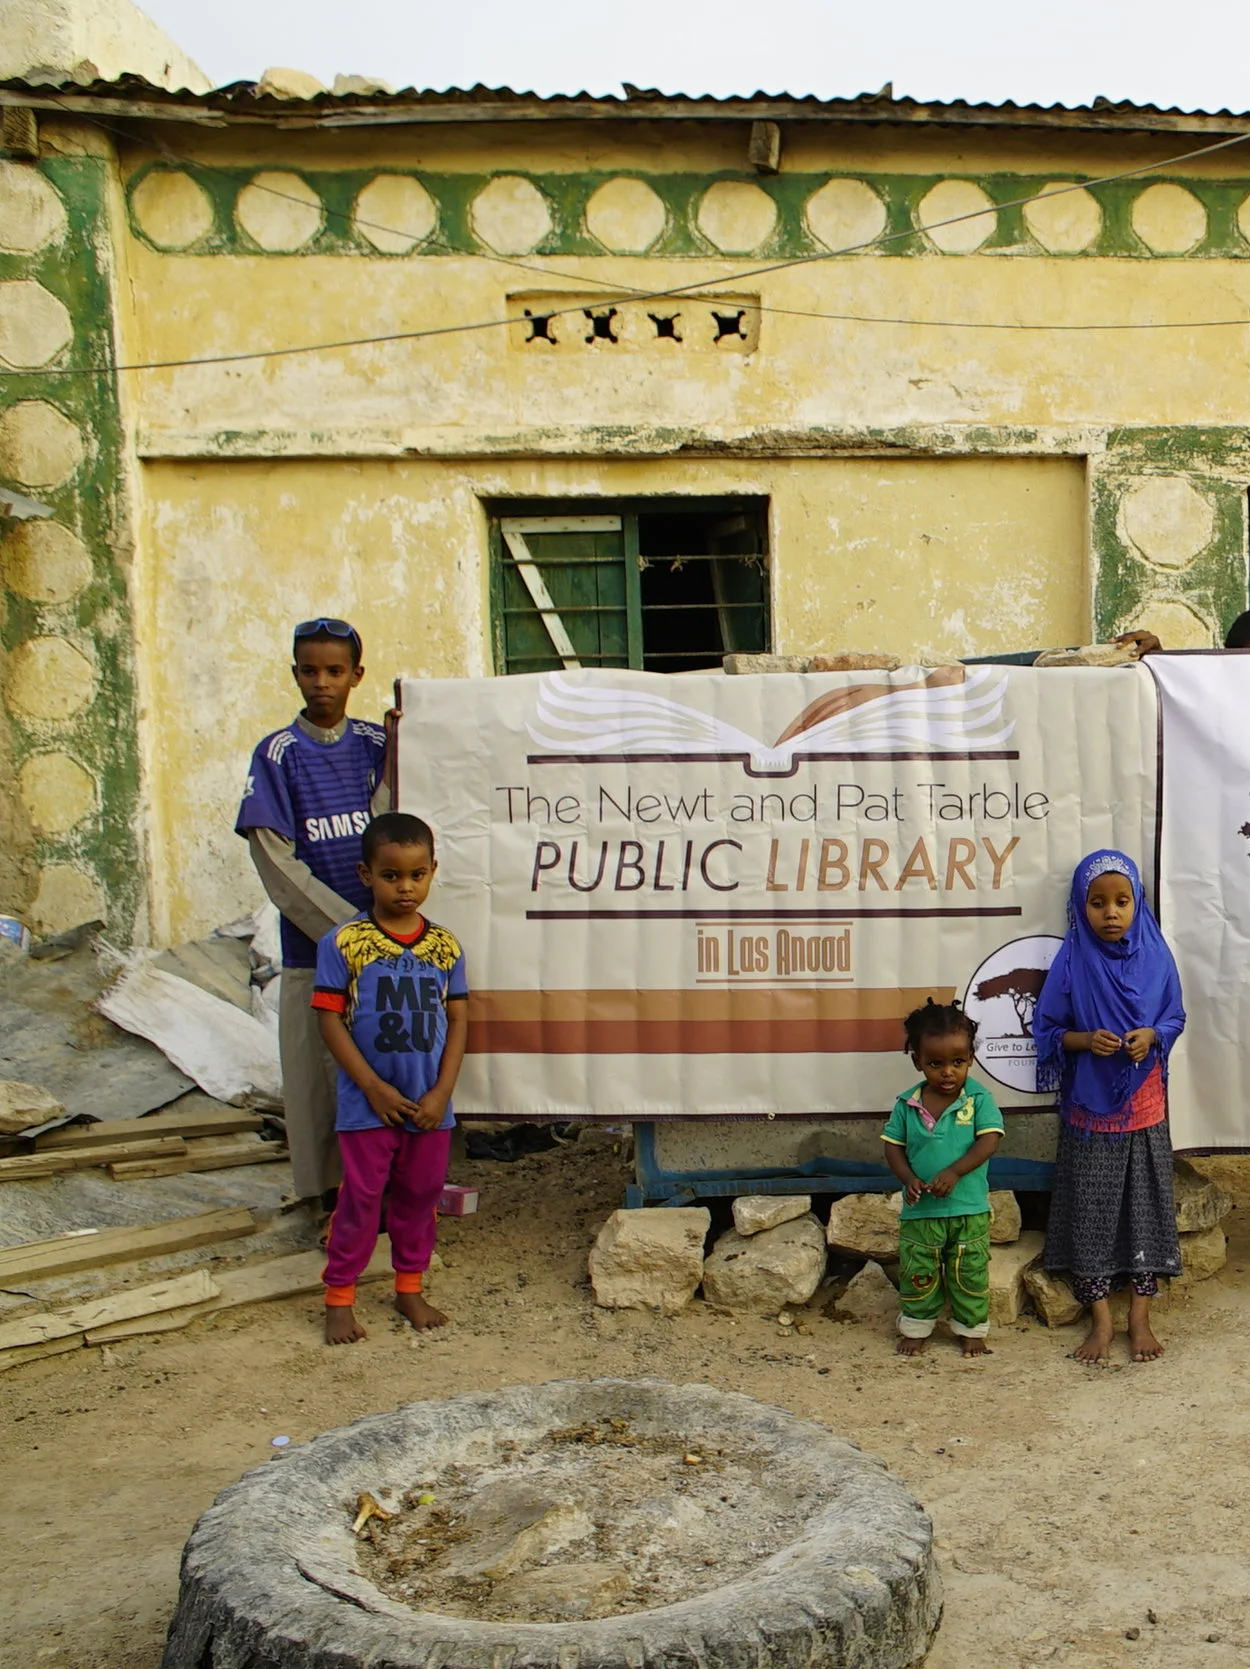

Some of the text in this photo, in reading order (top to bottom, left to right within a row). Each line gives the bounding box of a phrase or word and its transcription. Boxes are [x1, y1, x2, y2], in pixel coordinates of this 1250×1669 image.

[495, 782, 1050, 824] The Newt and Pat Tarble
[305, 811, 371, 842] SAMS
[531, 836, 1021, 892] PUBLIC LIBRARY
[697, 929, 720, 973] in
[727, 929, 769, 976] Las
[375, 975, 438, 1012] ME
[374, 1011, 437, 1054] &U
[986, 1042, 1009, 1052] Give
[1012, 1043, 1023, 1052] to
